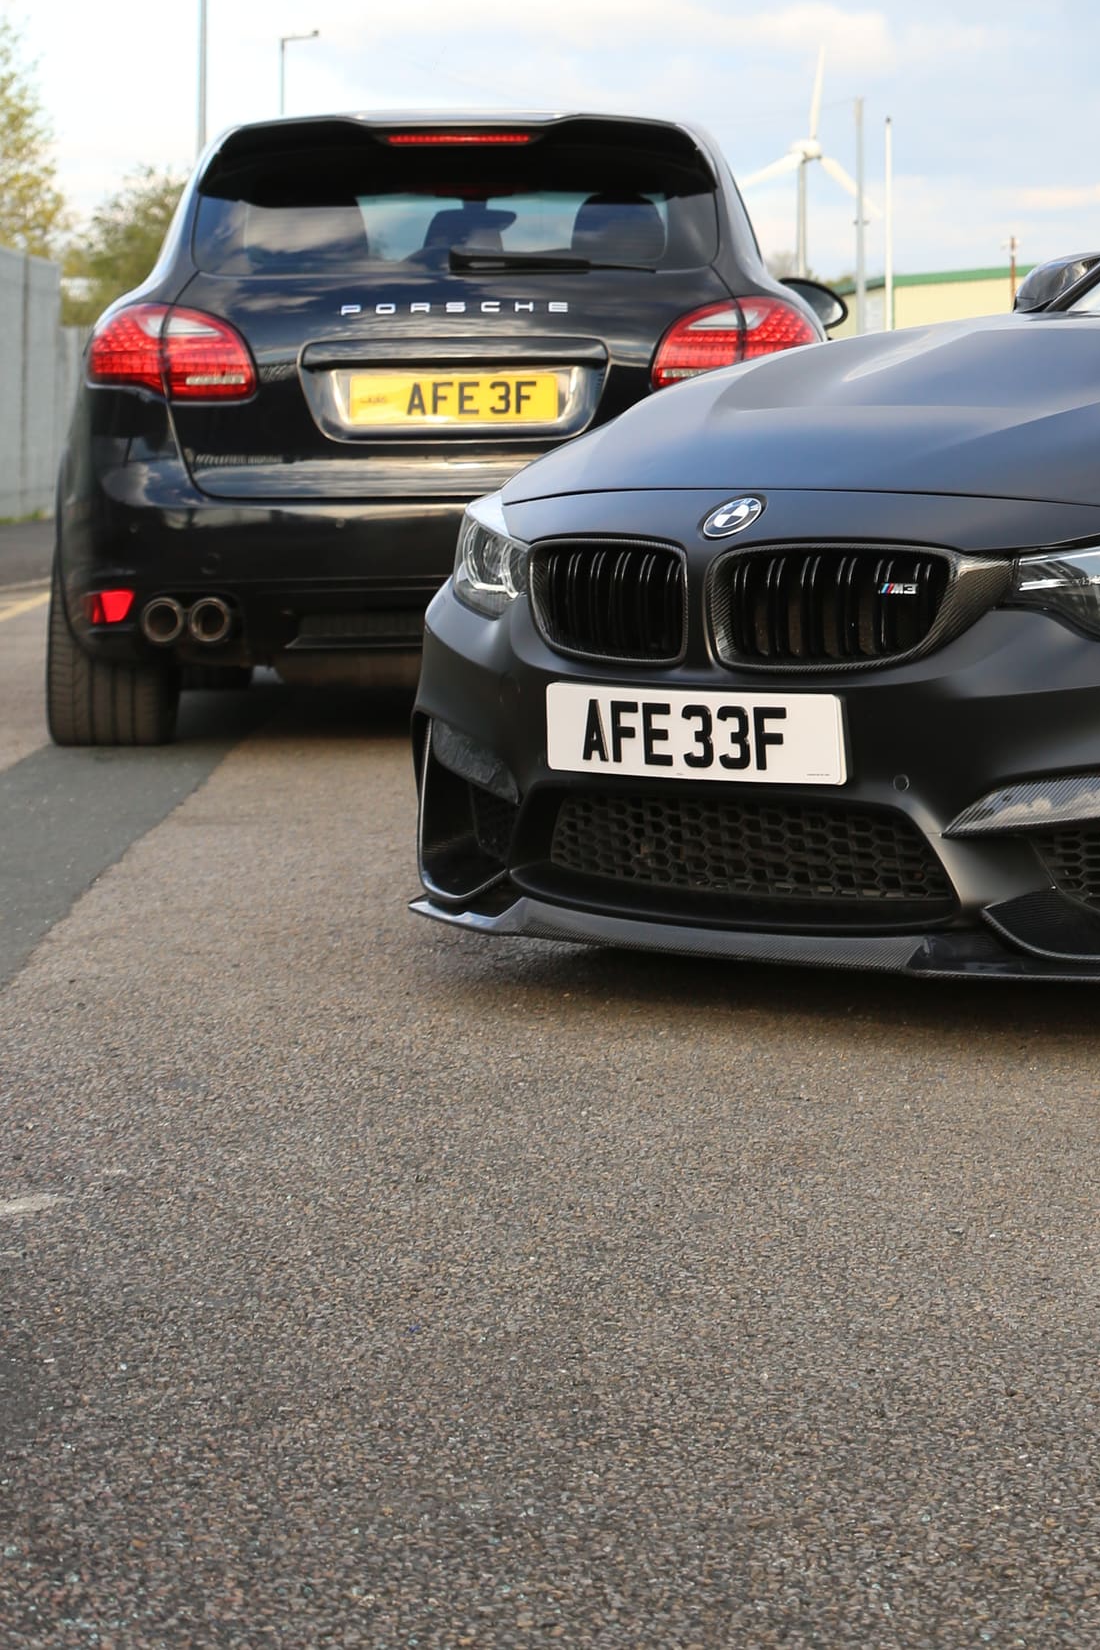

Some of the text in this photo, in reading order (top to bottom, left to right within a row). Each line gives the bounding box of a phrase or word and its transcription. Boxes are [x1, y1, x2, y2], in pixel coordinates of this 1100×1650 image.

[340, 301, 569, 316] PORSCHE
[407, 380, 537, 415] AFE 3F
[890, 582, 919, 595] M3
[582, 698, 787, 771] AFE 33F
